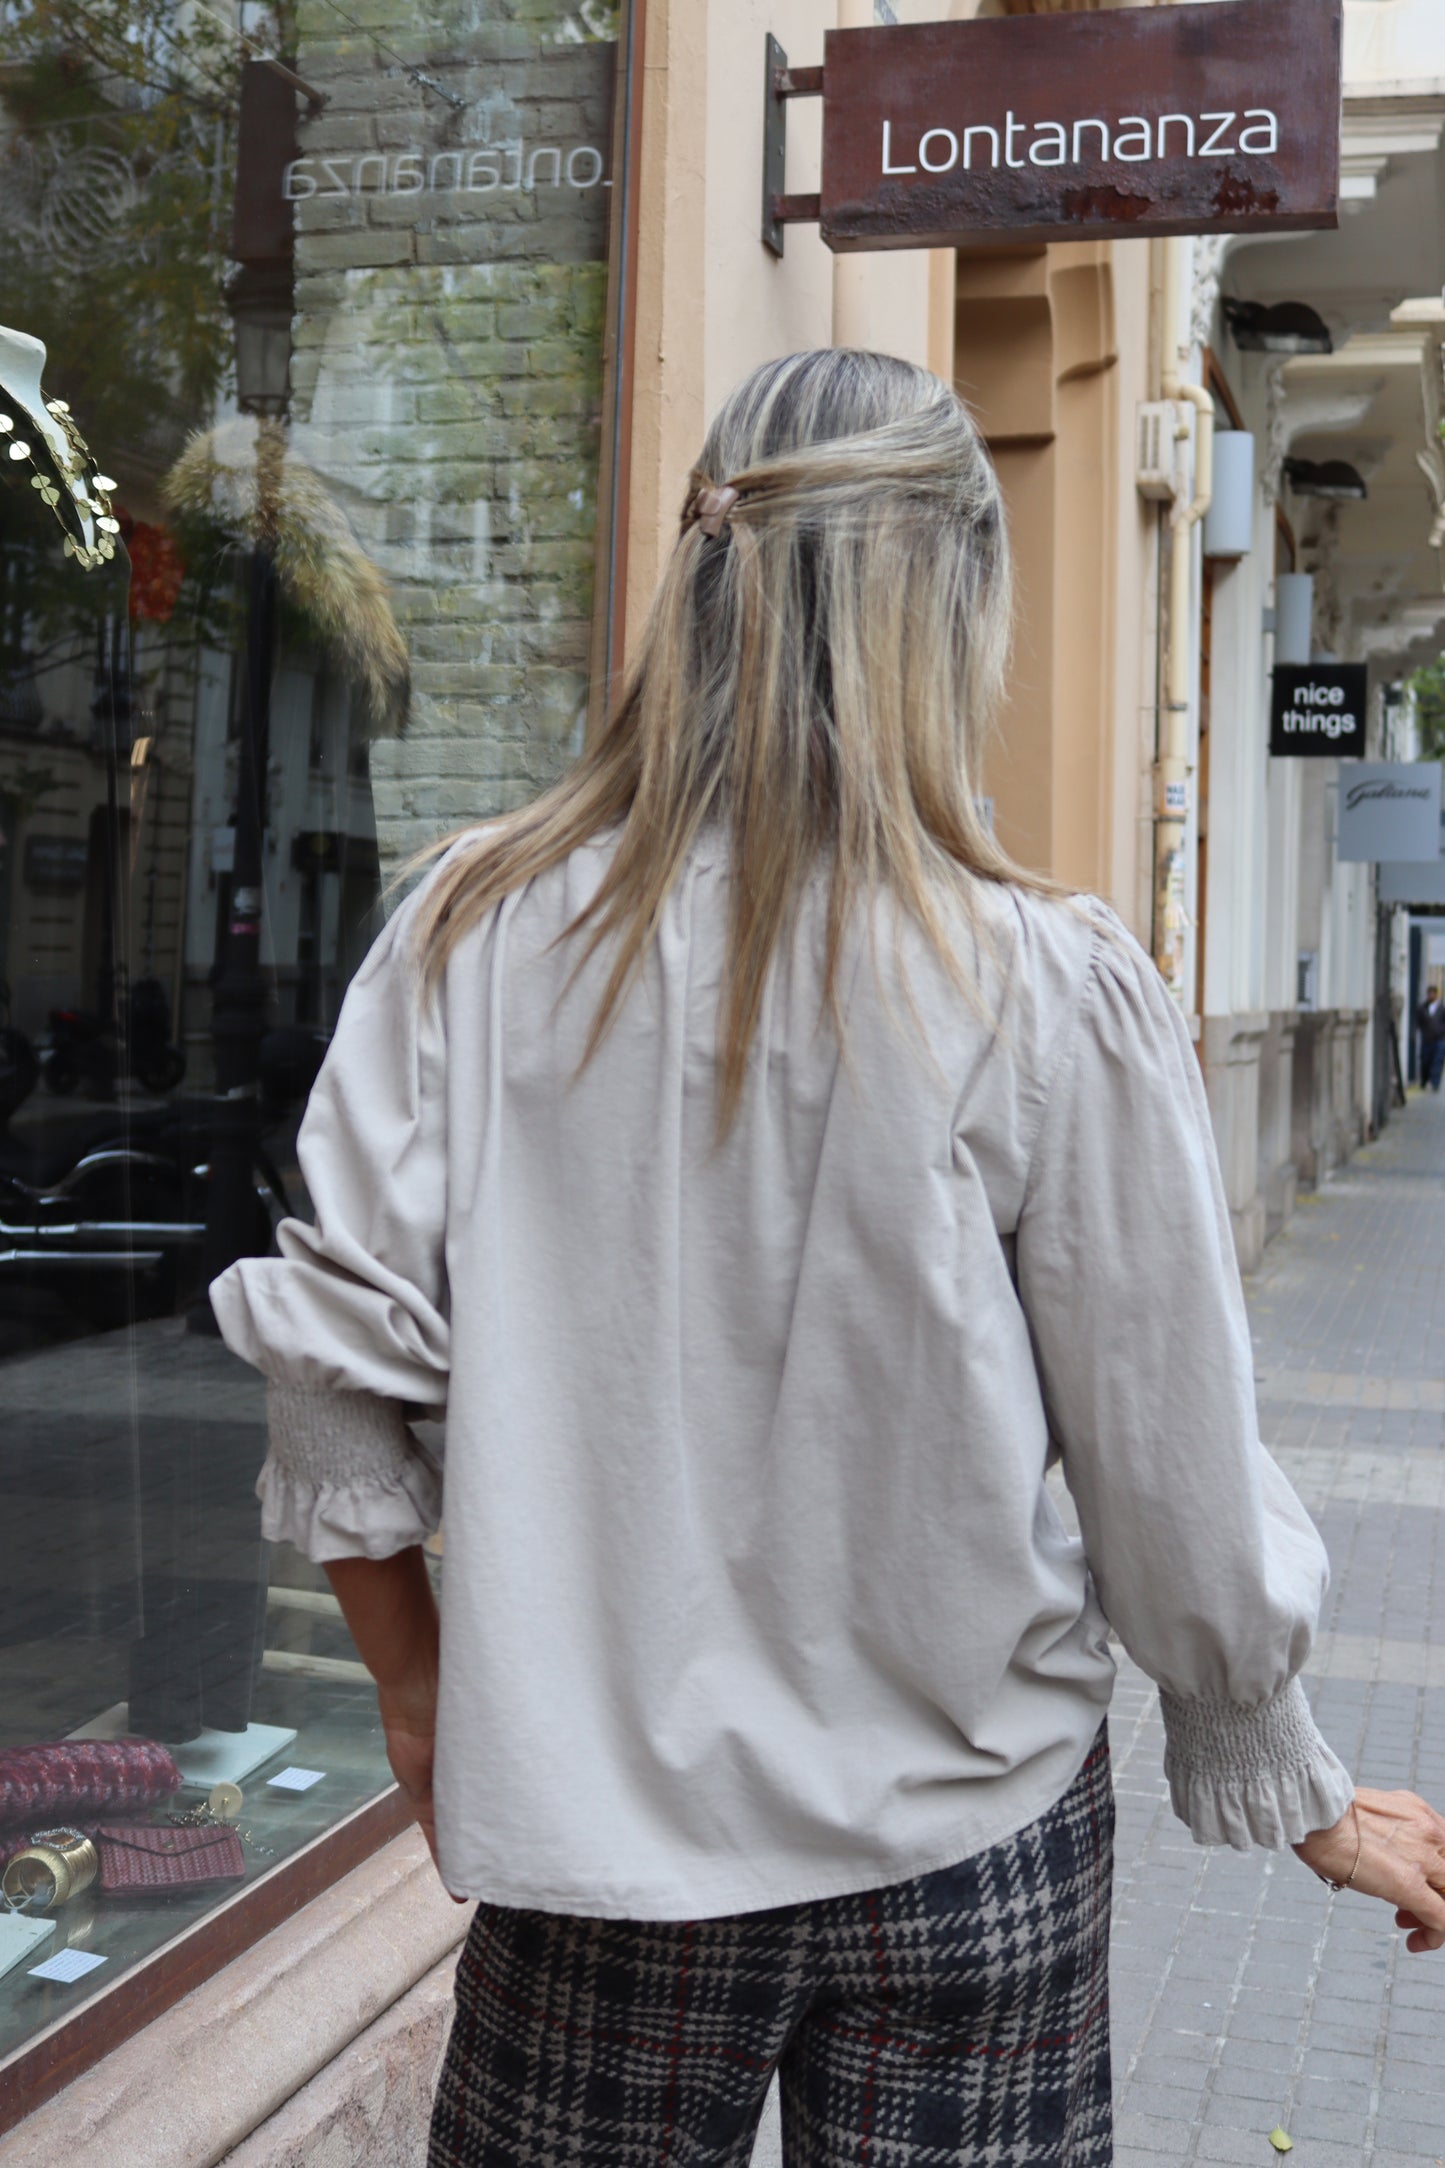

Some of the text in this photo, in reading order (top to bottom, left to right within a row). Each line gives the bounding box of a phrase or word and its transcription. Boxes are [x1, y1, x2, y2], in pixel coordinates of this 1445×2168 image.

[881, 108, 1278, 175] Lontananza
[1294, 682, 1344, 706] nice
[1282, 709, 1356, 739] things
